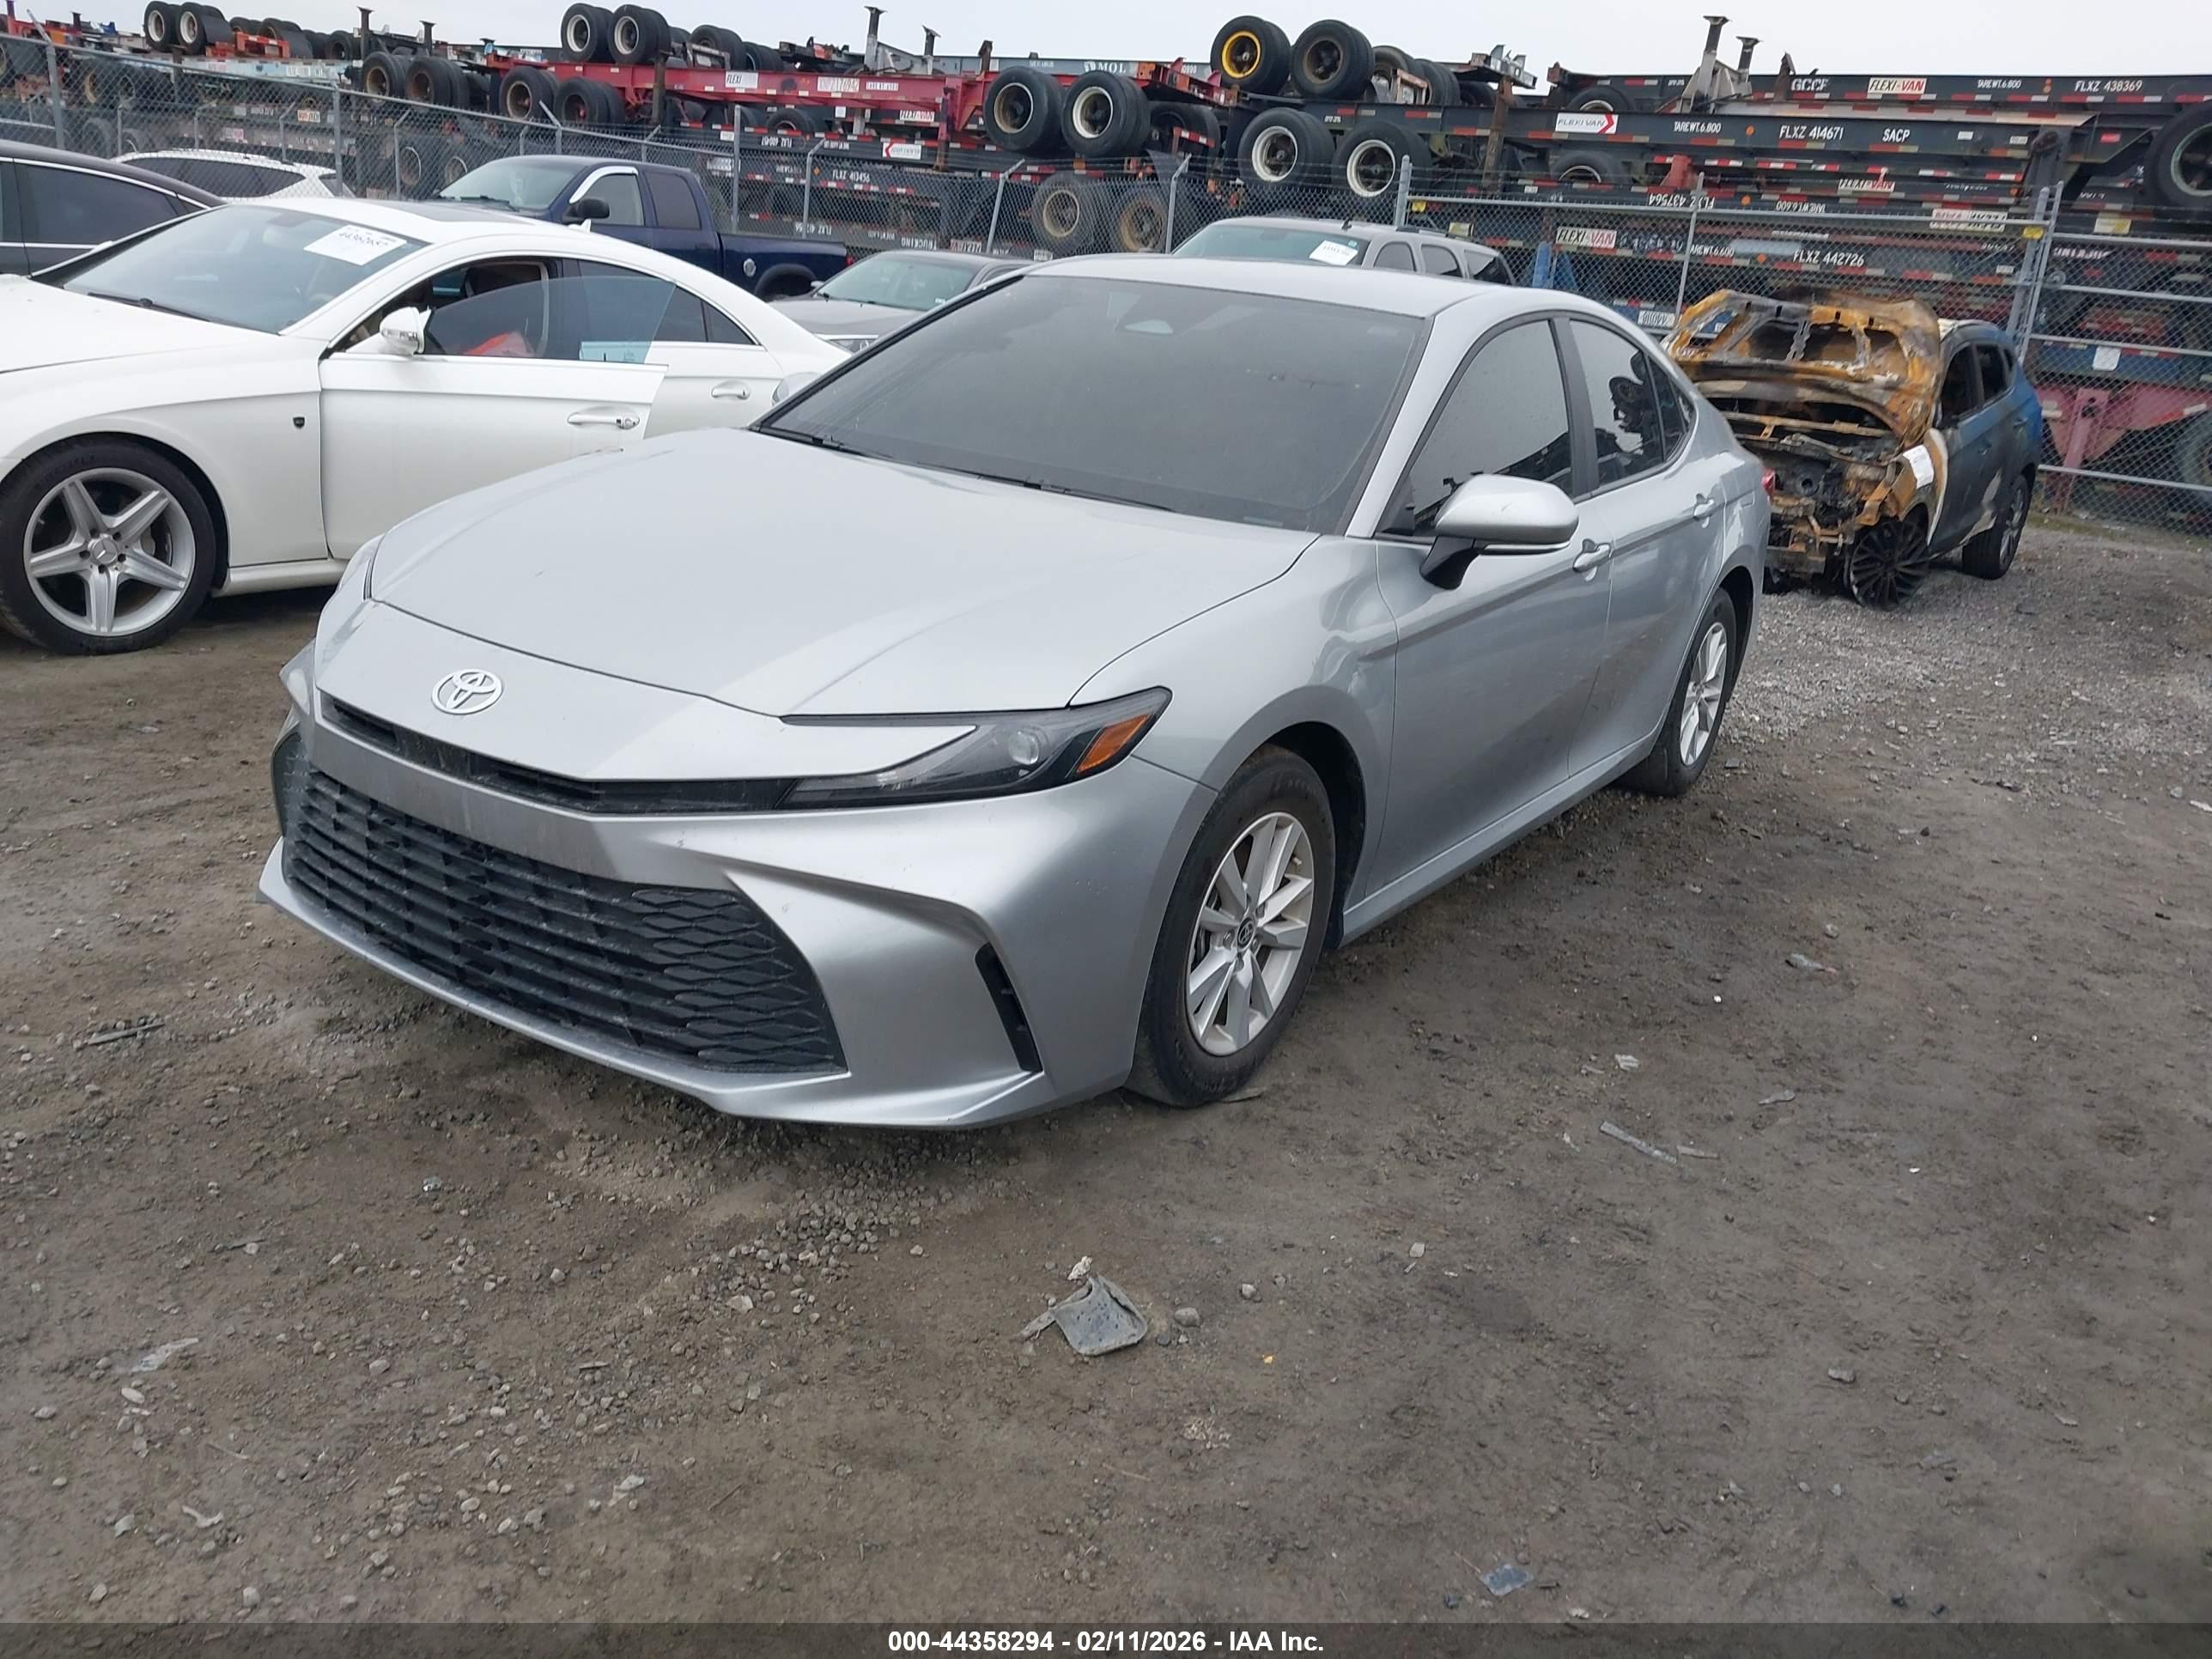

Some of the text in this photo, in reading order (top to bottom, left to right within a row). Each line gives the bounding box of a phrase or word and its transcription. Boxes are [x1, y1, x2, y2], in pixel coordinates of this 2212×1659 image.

[1098, 63, 1127, 74] MOL
[727, 74, 742, 84] FLEXI
[2075, 80, 2143, 93] FLXZ 438369
[1779, 125, 1844, 141] FLXZ 414671
[1882, 129, 1911, 143] SACP
[1648, 192, 1686, 207] 437564
[1558, 228, 1585, 245] FLEXI
[901, 237, 937, 251] TRUCKING
[1793, 248, 1865, 268] FLXZ 442726
